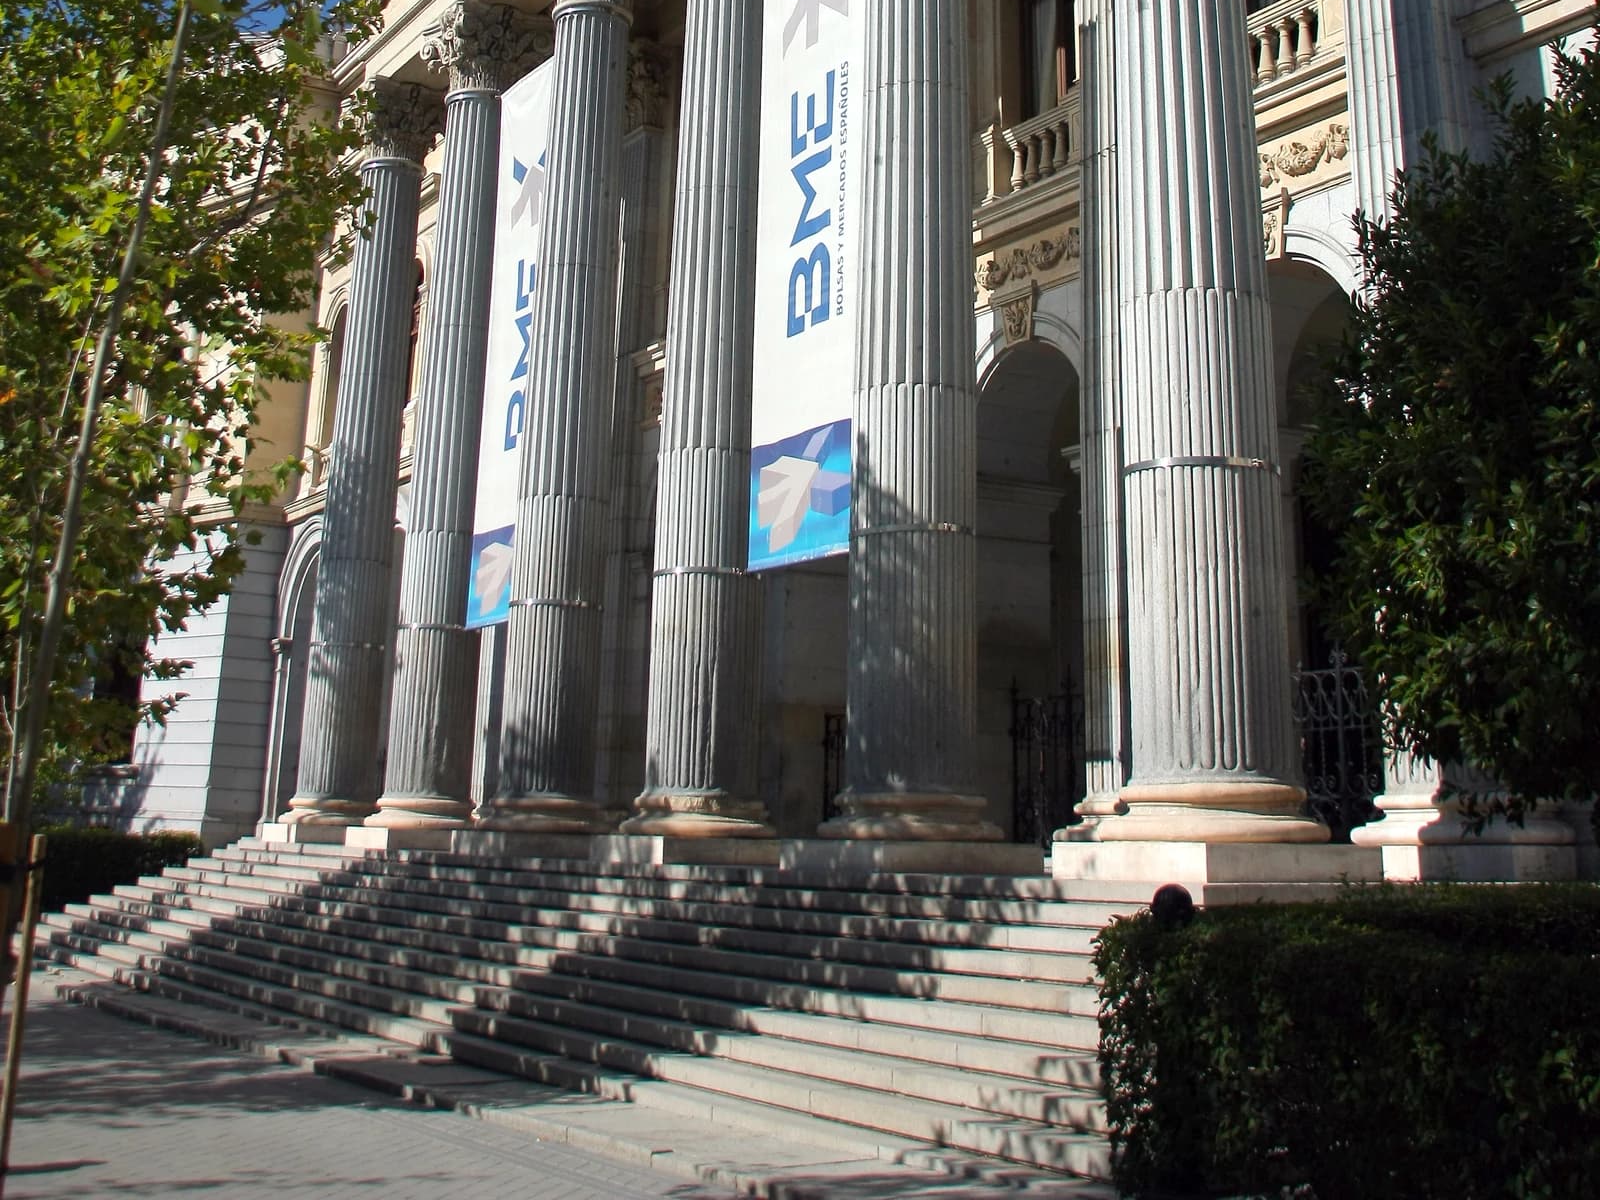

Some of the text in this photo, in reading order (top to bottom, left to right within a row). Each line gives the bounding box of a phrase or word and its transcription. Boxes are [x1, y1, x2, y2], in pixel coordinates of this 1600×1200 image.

[786, 69, 836, 339] BME
[836, 60, 850, 317] BOLSAS Y MERCADOS ESPAÑOLES
